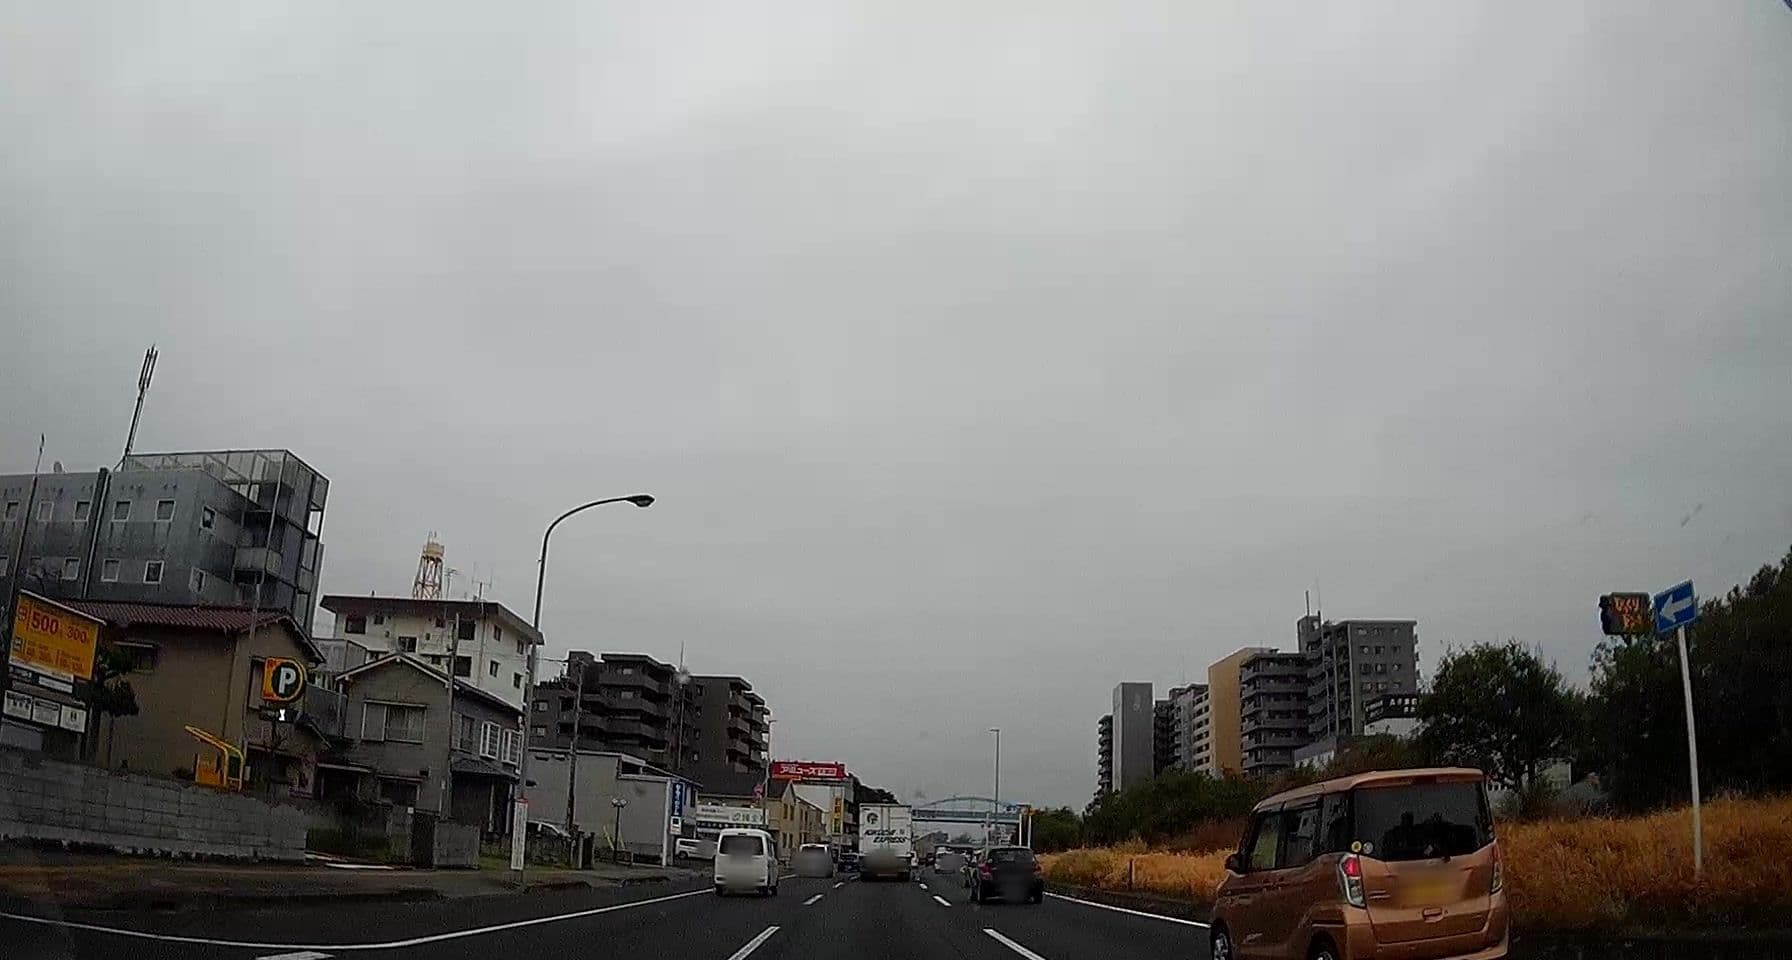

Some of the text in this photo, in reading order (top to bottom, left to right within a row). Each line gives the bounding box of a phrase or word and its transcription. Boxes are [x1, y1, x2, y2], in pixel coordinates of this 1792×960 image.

[31, 611, 59, 635] 500
[67, 625, 87, 644] 300
[278, 666, 297, 694] P
